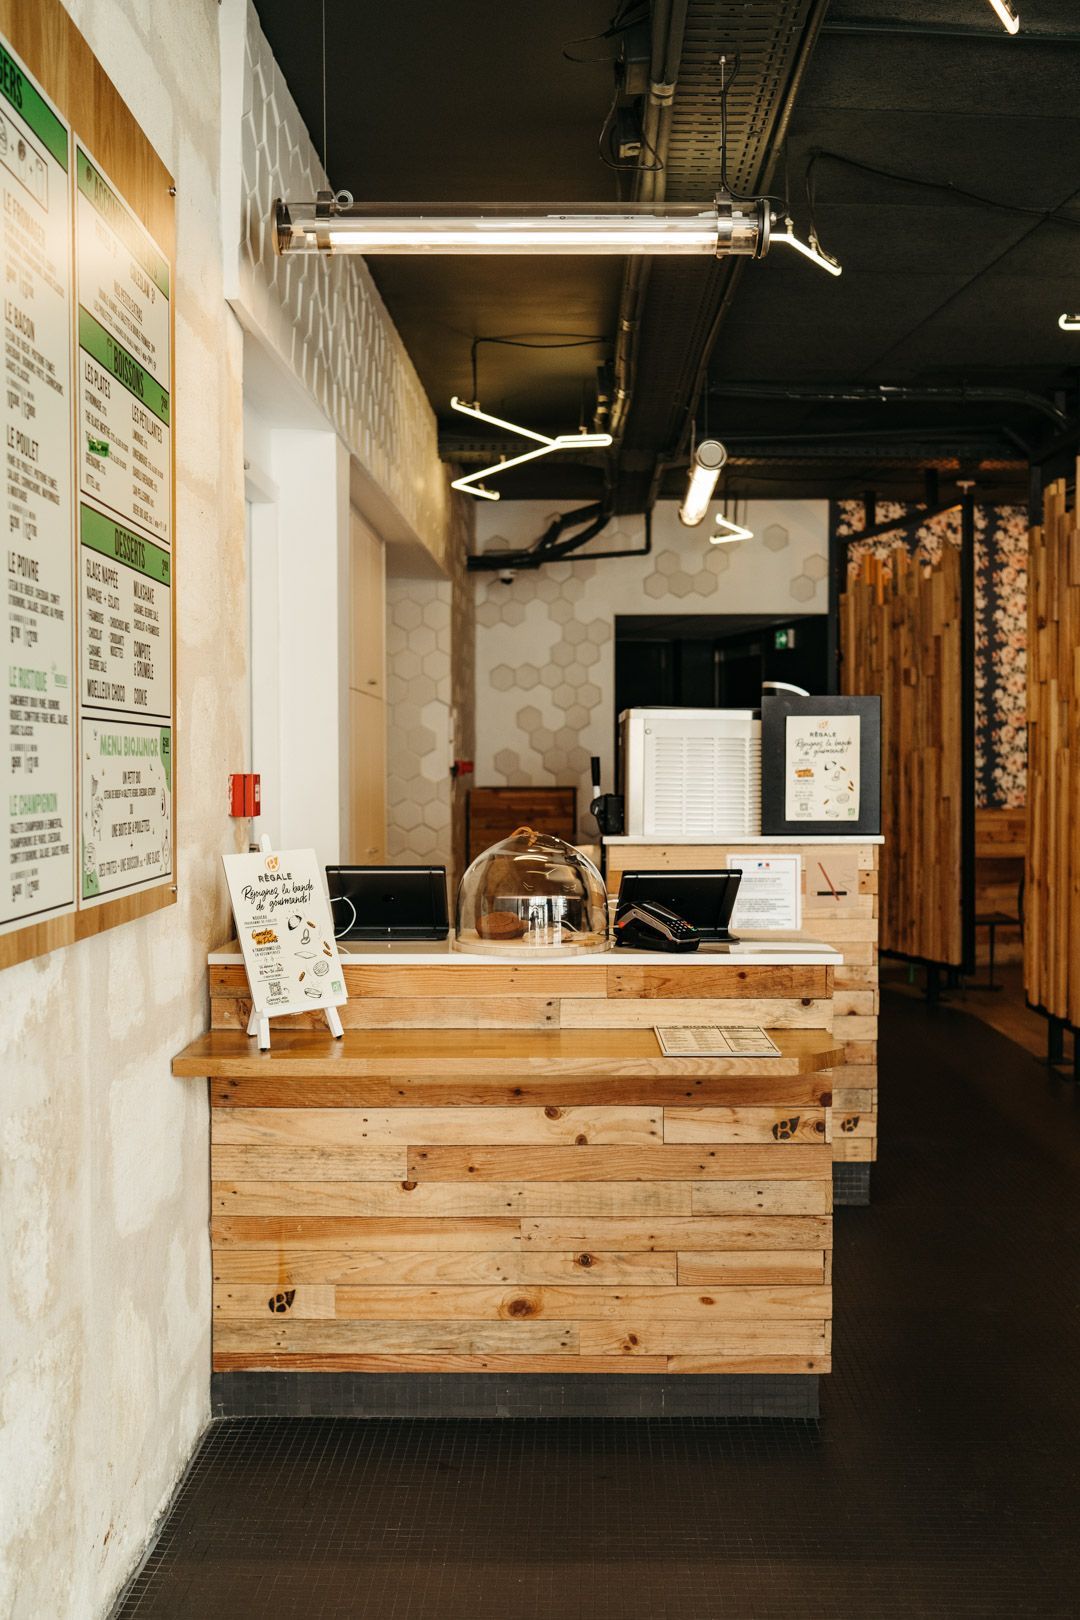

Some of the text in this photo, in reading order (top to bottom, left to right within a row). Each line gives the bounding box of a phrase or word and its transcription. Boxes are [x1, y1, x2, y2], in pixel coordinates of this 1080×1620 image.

[85, 360, 93, 384] LES
[94, 369, 111, 400] PLATES
[114, 345, 144, 398] BOISSONS
[7, 424, 14, 449] LE
[16, 430, 39, 463] POULET
[115, 528, 145, 569] DESSERTS
[8, 550, 39, 582] LE POIVRE
[86, 558, 101, 582] GLACE
[100, 734, 122, 756] MENU
[123, 735, 159, 757] BIOJUNIOR
[9, 794, 17, 816] LE
[282, 883, 290, 894] la
[292, 878, 313, 894] bande
[256, 899, 264, 912] de
